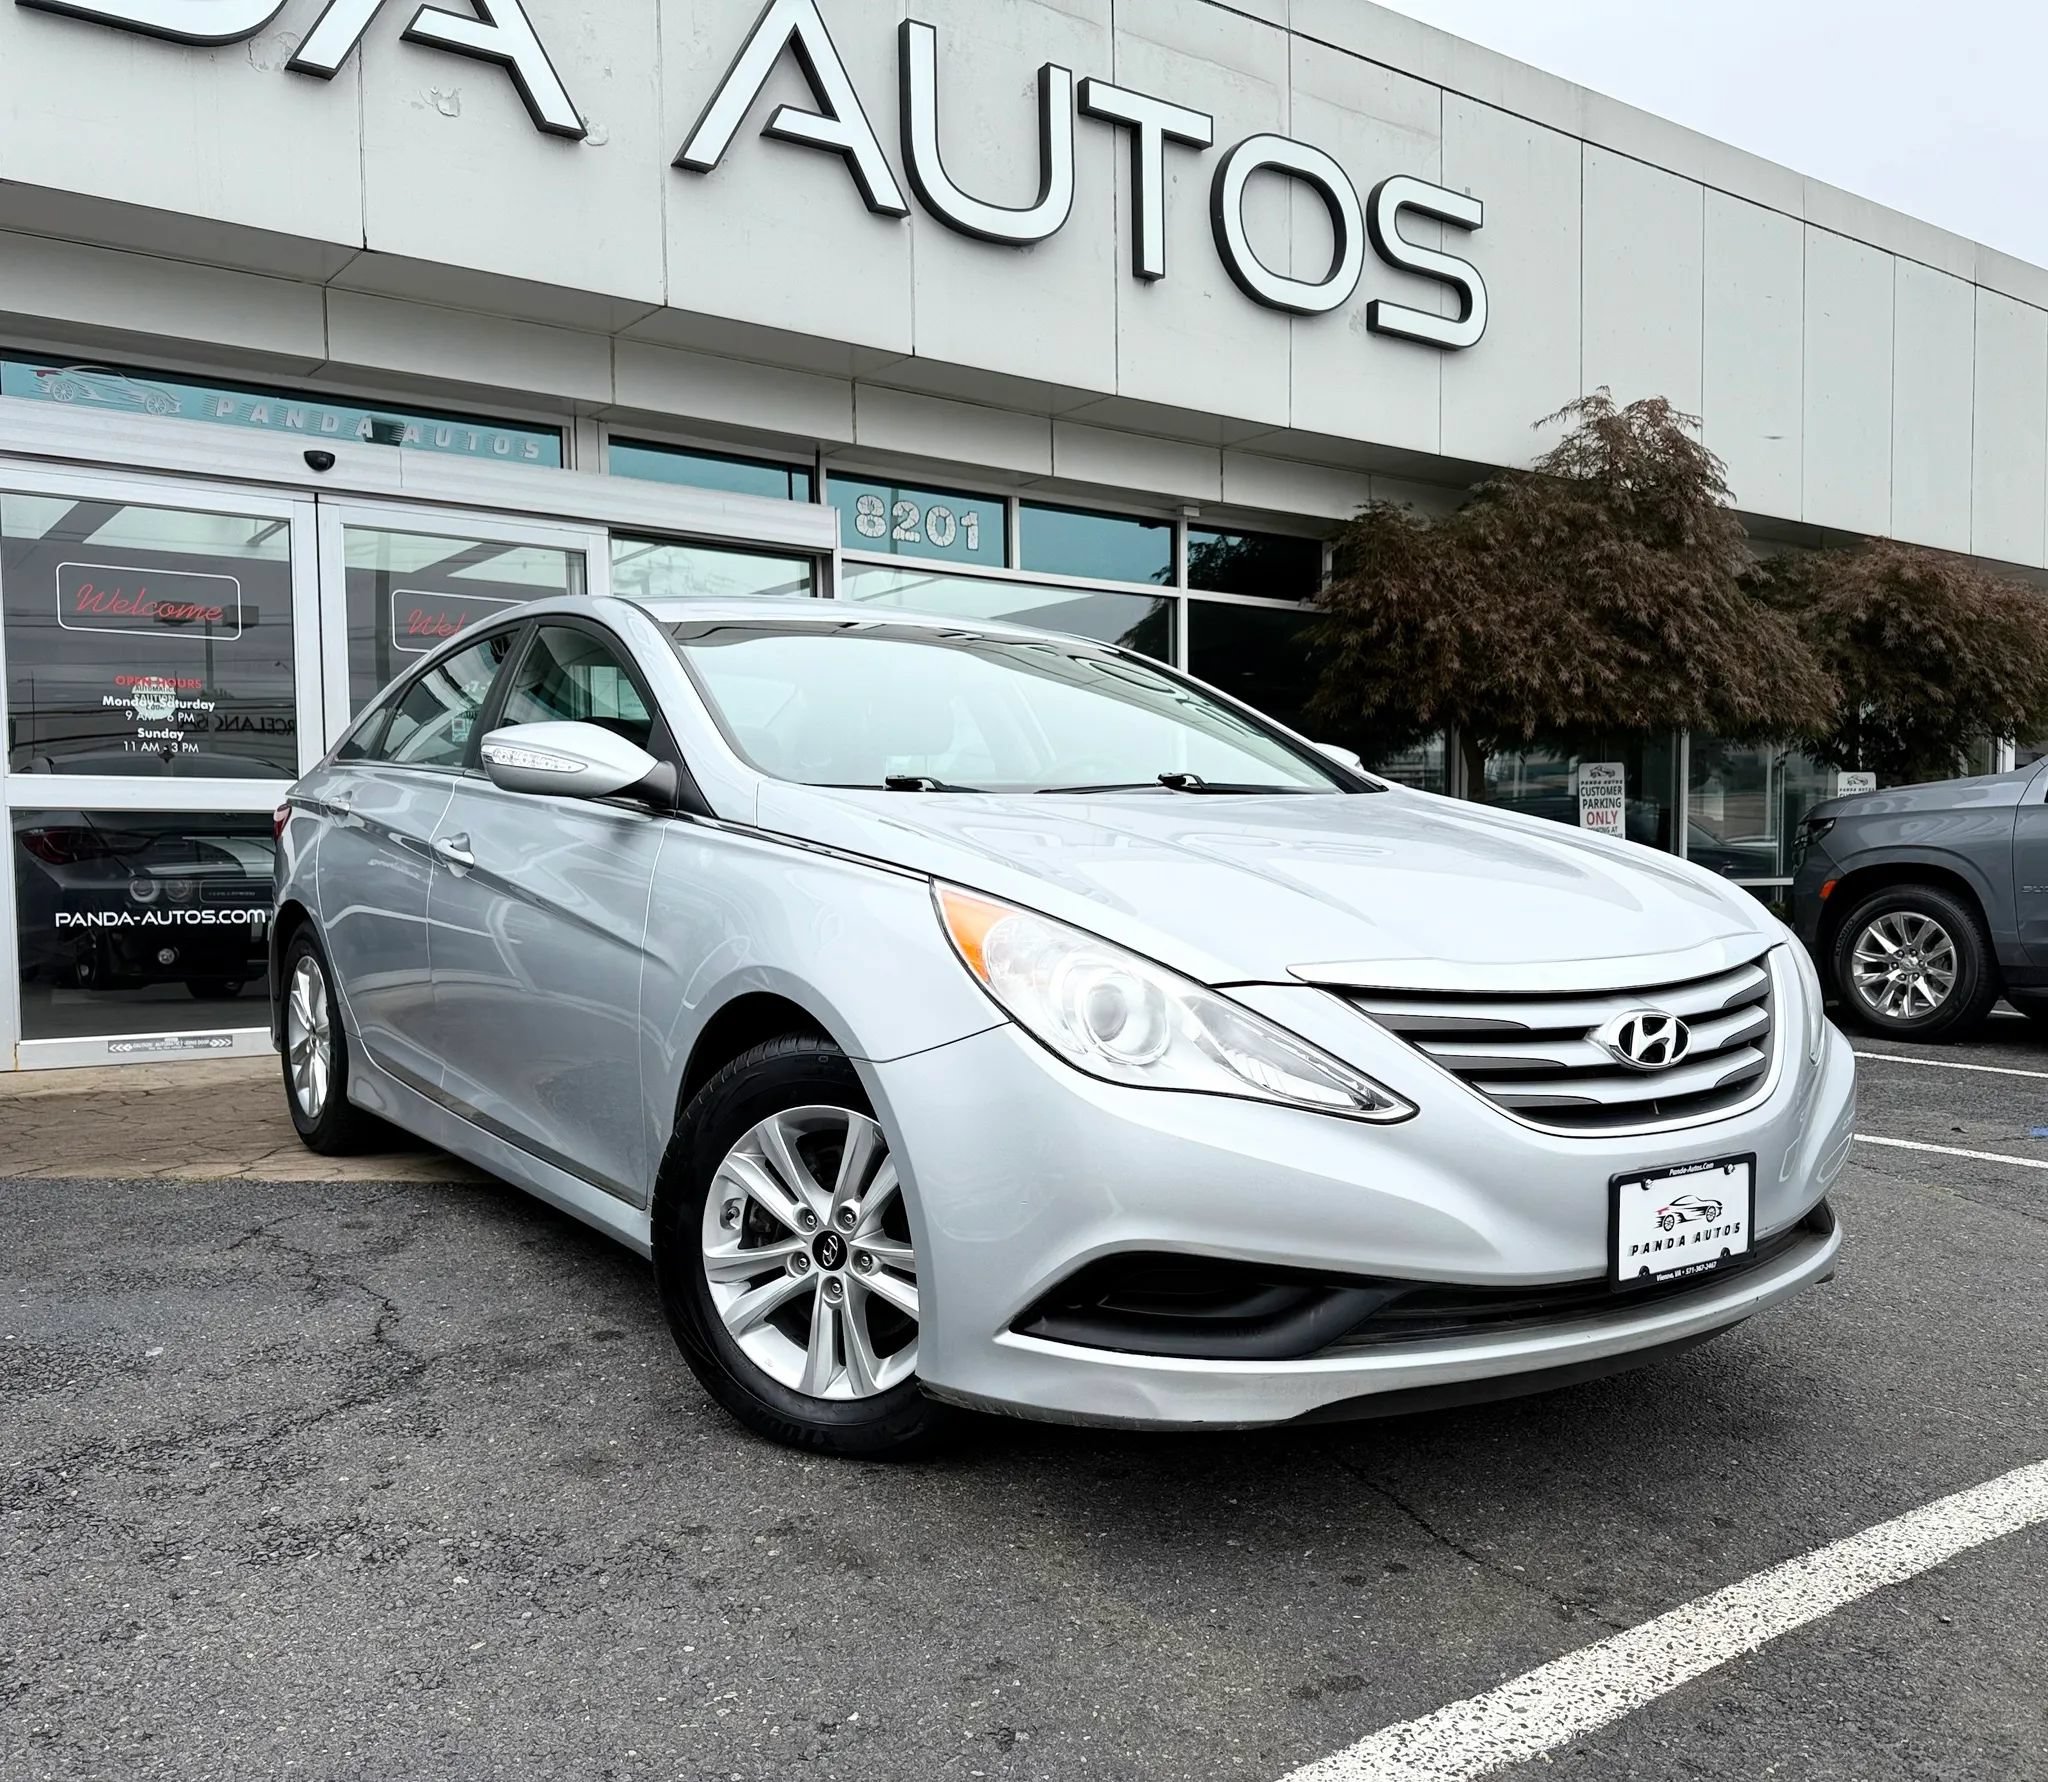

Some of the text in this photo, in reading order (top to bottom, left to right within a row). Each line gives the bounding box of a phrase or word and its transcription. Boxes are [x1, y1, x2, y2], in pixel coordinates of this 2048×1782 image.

[671, 0, 1488, 351] AUTOS
[210, 395, 541, 460] PANDA AUTOS
[855, 494, 979, 551] 8201
[76, 583, 224, 623] Welcome
[125, 710, 133, 721] 9
[178, 712, 195, 723] PM
[137, 727, 185, 741] Sunday
[123, 741, 137, 752] 11
[140, 742, 161, 752] AM
[171, 742, 179, 753] 3
[182, 743, 199, 753] PM
[1580, 786, 1623, 797] CUSTOMER
[1582, 797, 1622, 809] PARKING
[1586, 810, 1618, 826] ONLY
[1629, 1221, 1741, 1257] PANDA AUTOS
